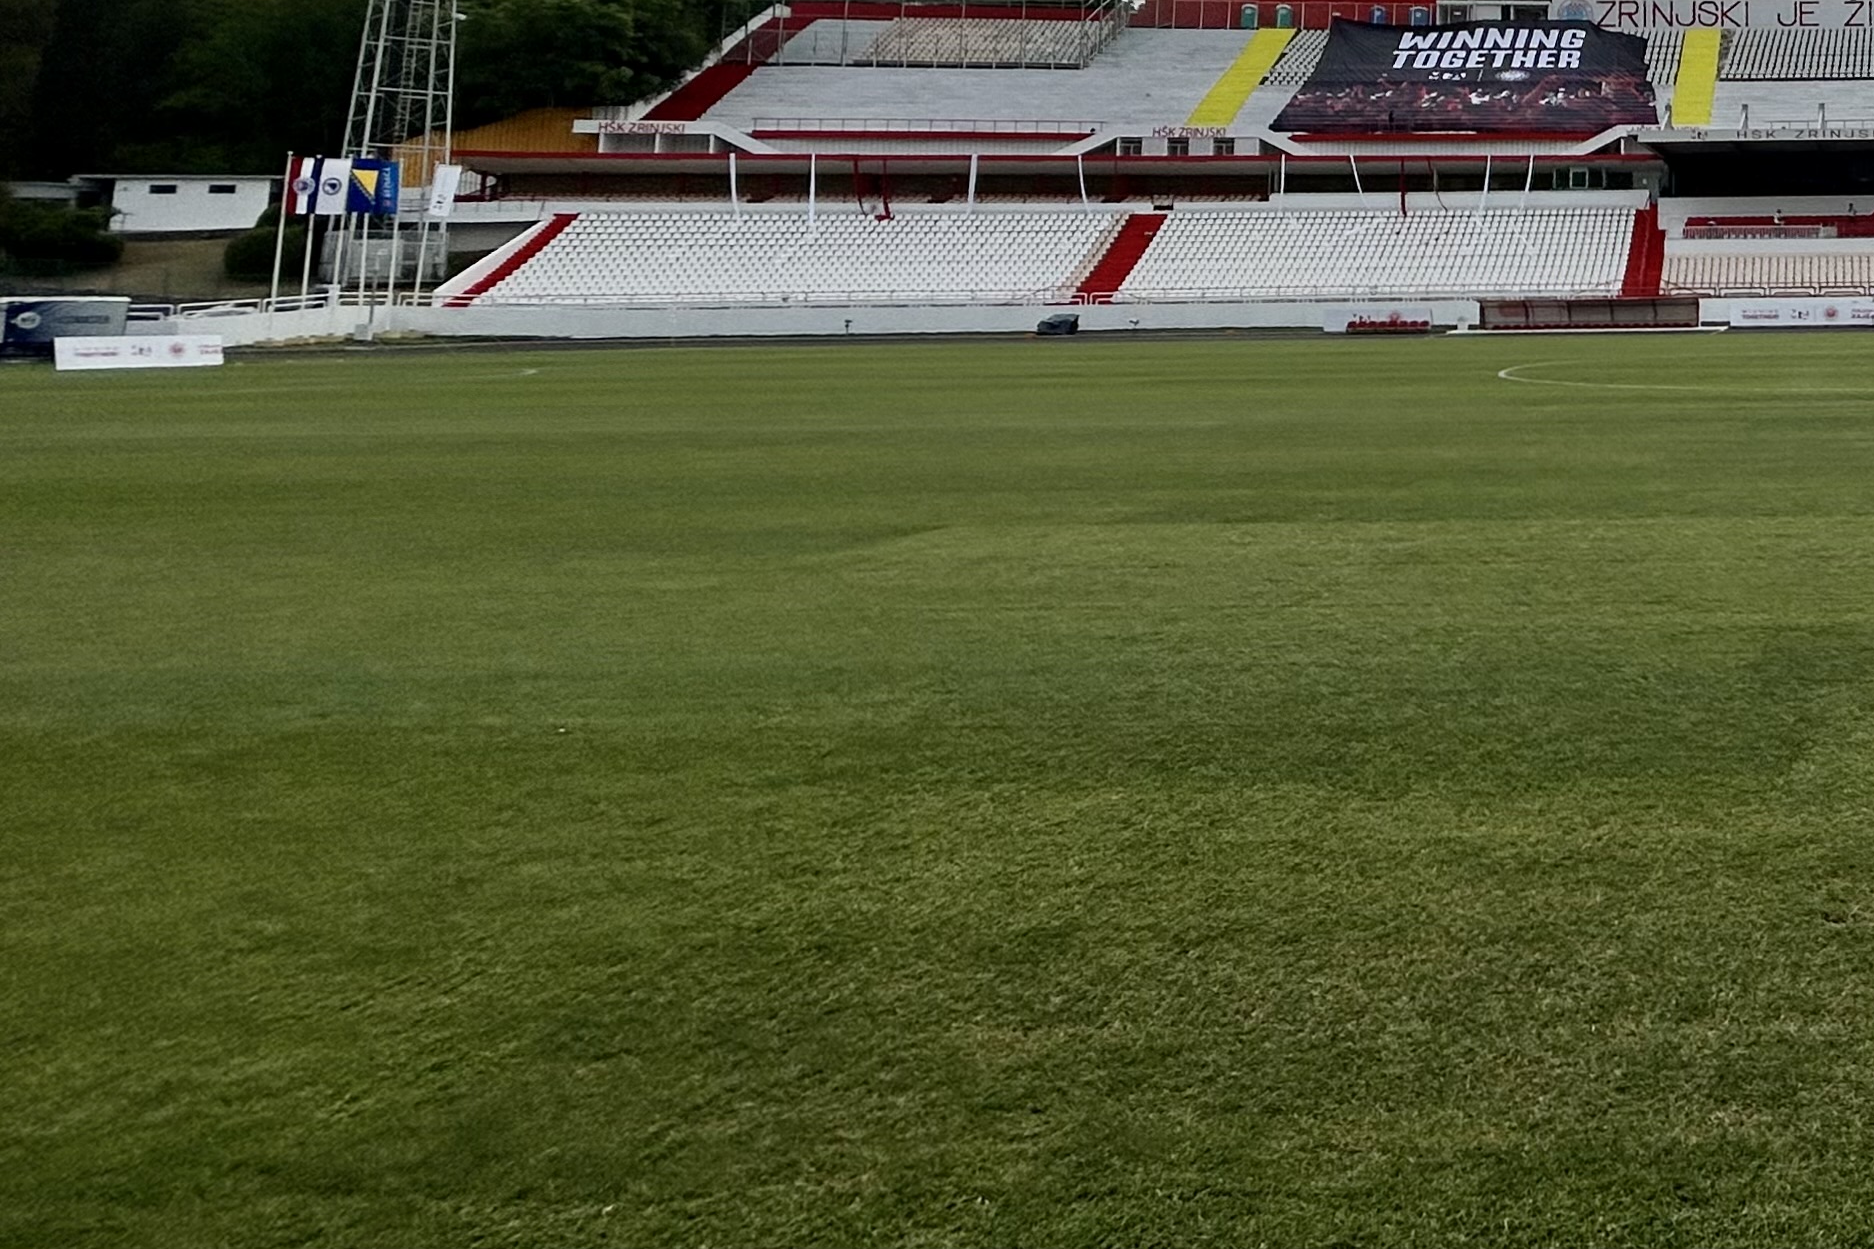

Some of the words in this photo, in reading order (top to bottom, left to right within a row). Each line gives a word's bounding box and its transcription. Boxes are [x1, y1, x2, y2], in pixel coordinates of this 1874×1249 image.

[1596, 1, 1750, 28] ZRINJSKI
[1777, 1, 1820, 27] JE
[1398, 28, 1586, 50] WINNING
[1392, 50, 1582, 69] TOGETHER
